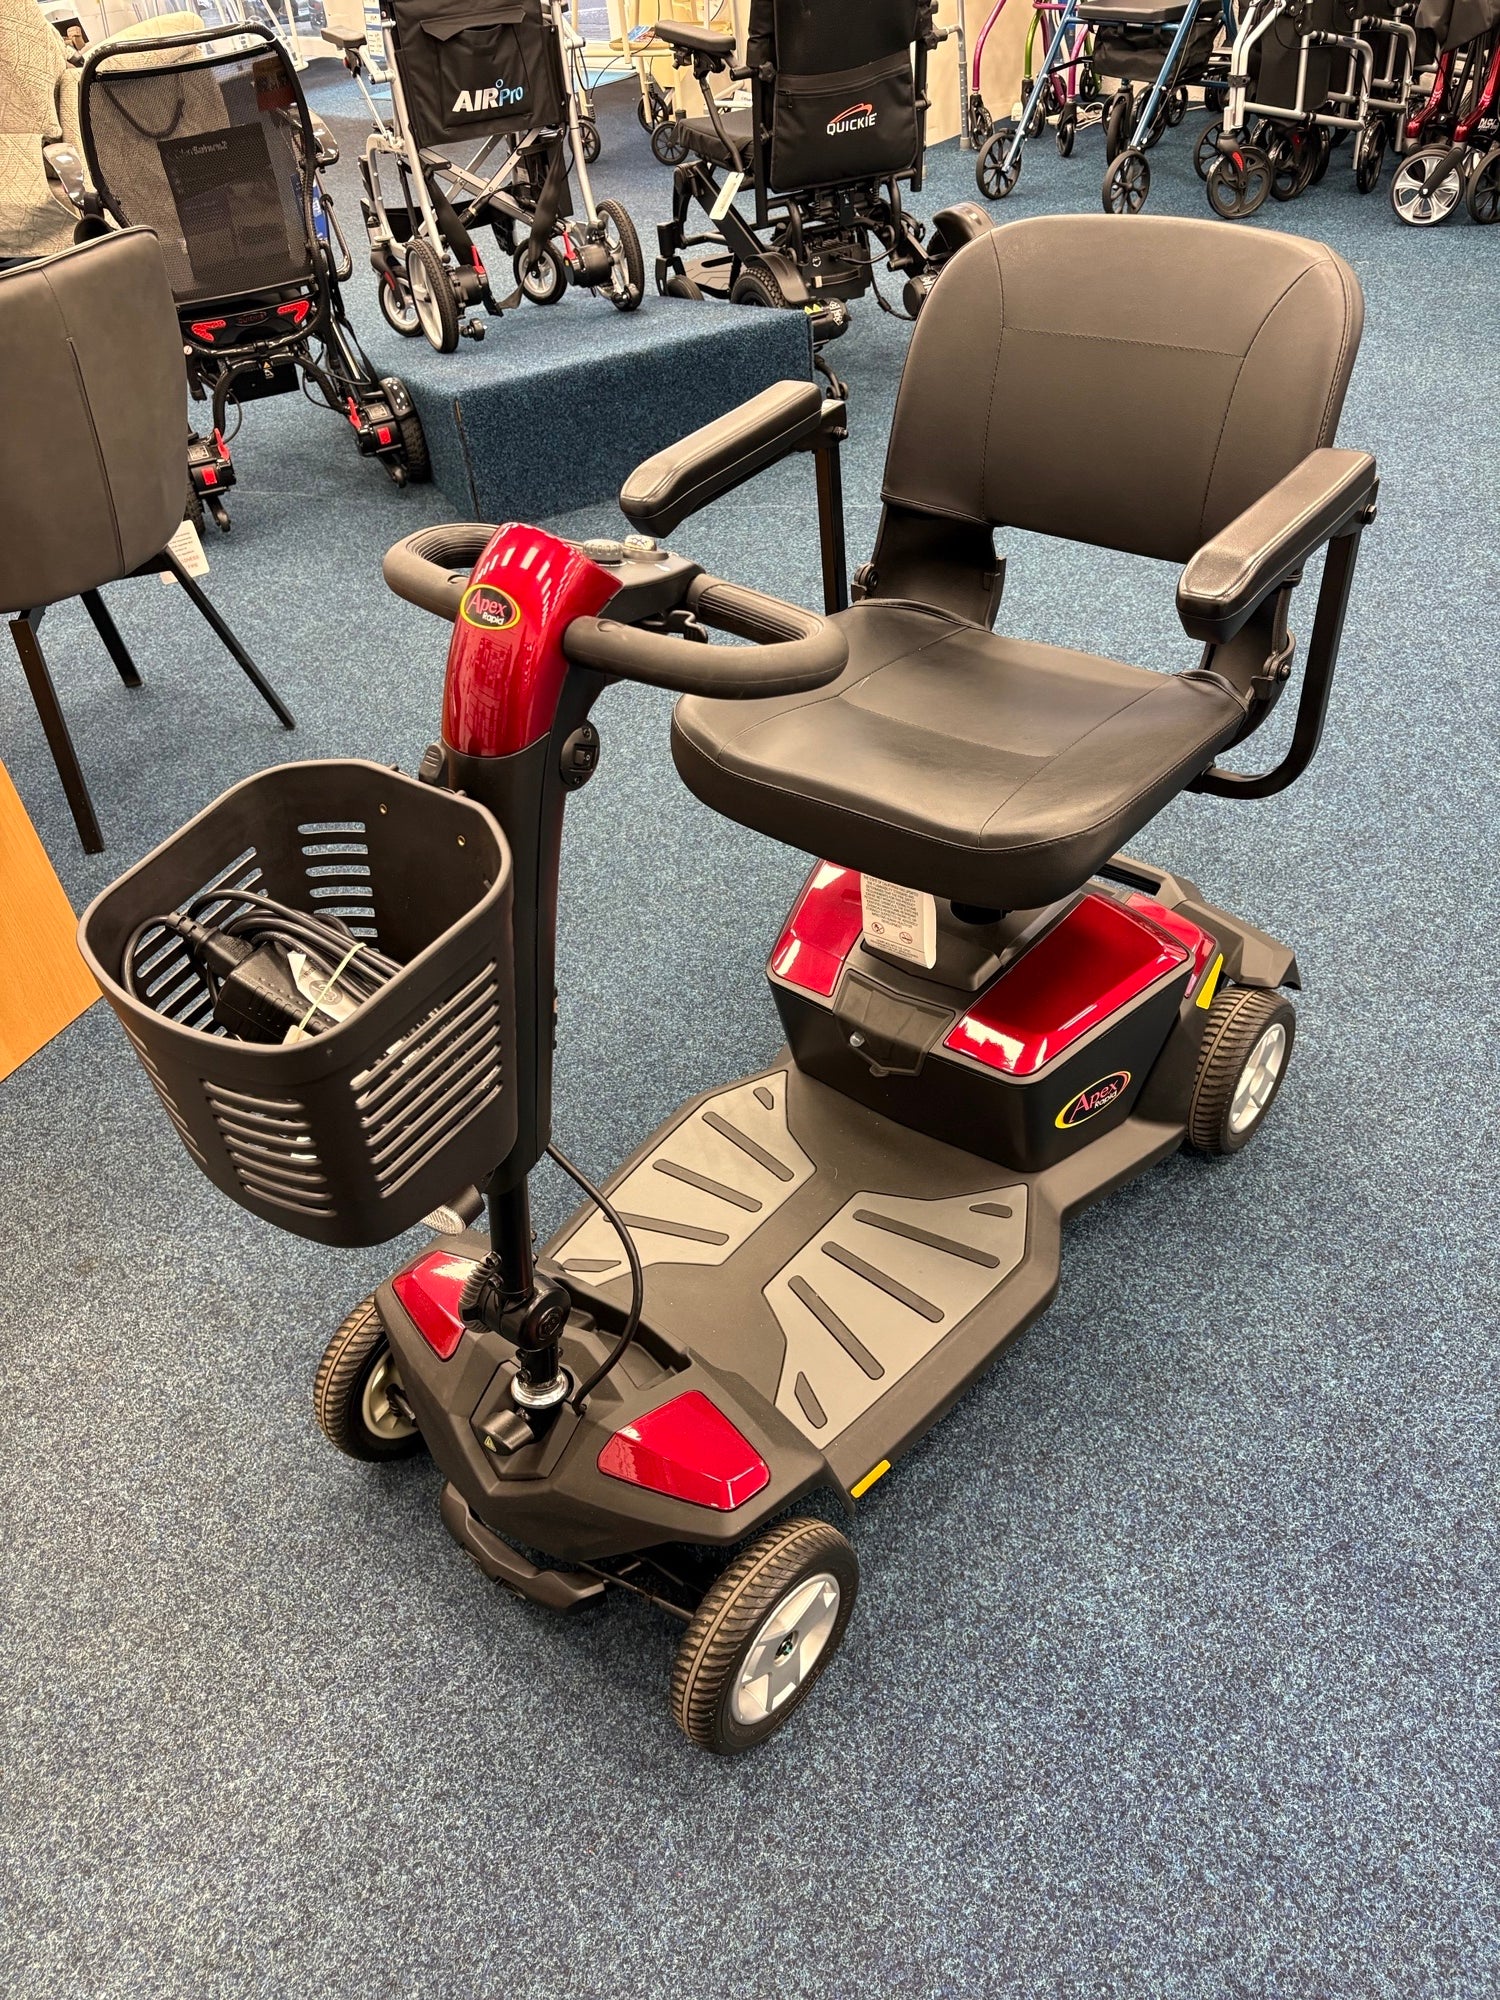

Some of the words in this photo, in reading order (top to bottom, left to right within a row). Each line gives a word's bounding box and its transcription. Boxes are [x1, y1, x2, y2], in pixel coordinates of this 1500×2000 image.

[826, 112, 878, 136] QUICKIE
[466, 589, 507, 617] Apex
[482, 612, 504, 625] Rapid
[1068, 1079, 1118, 1123] Apex
[1094, 1089, 1118, 1109] Rapid
